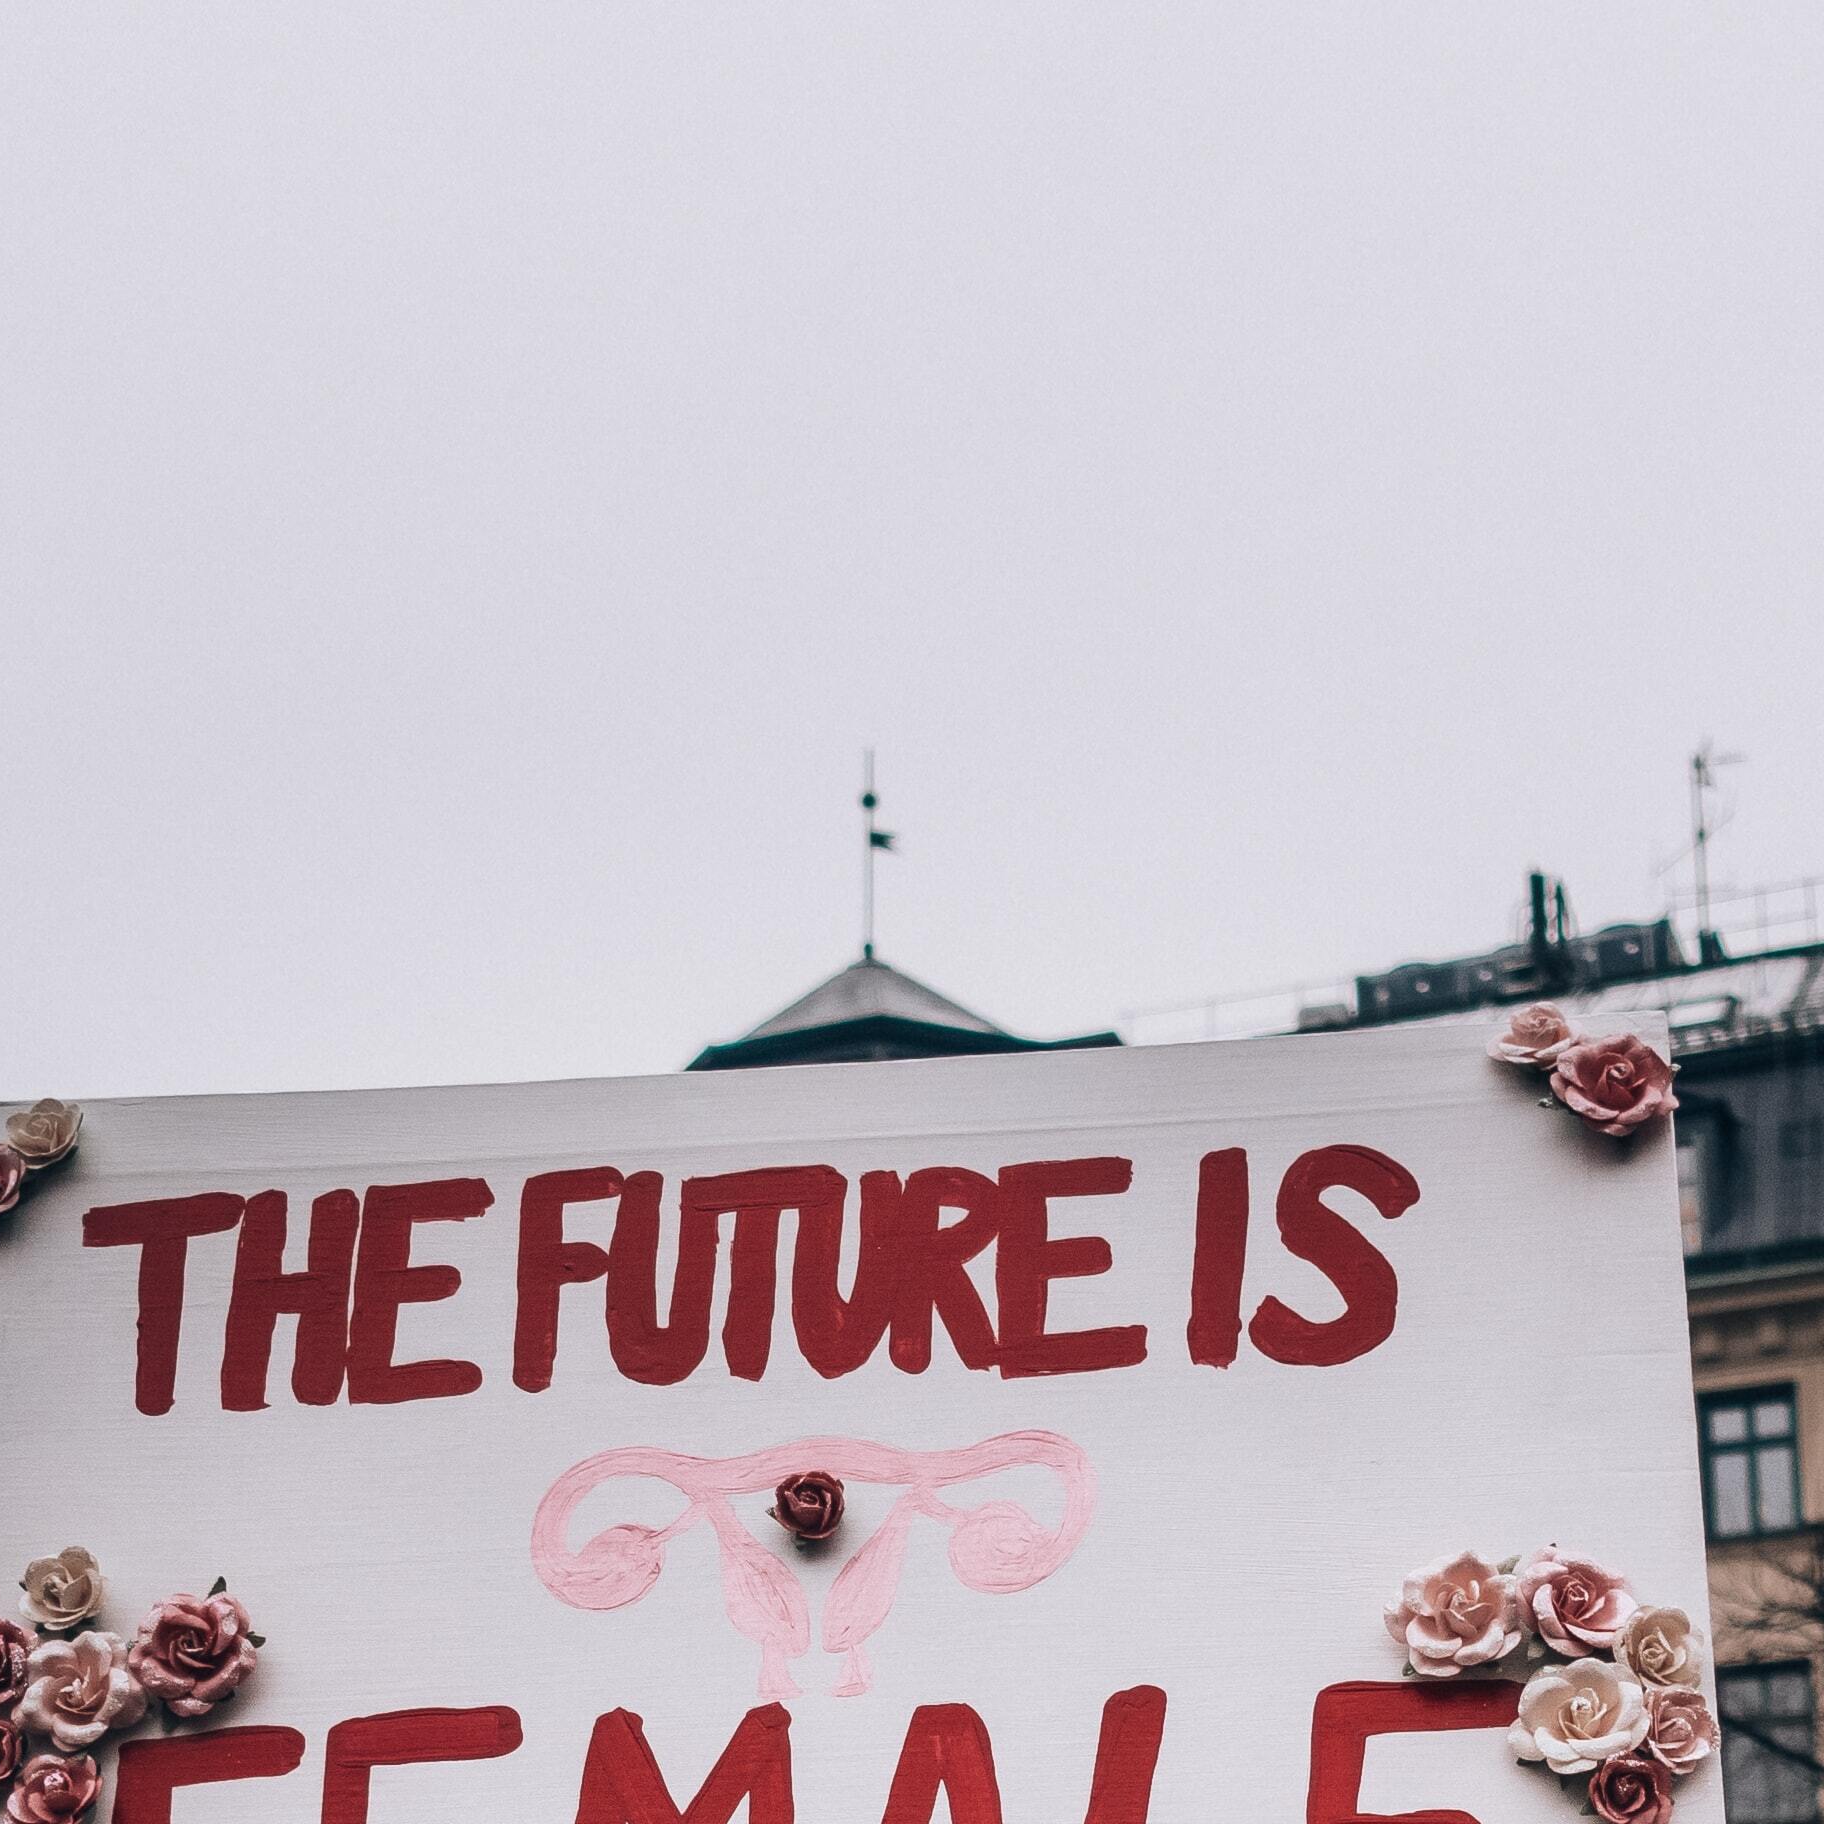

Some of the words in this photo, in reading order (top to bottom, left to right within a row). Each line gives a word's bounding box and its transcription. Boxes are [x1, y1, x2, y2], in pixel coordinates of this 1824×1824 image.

[82, 1176, 495, 1417] THE
[512, 1156, 1149, 1394] FUTURE
[1188, 1144, 1421, 1370] IS
